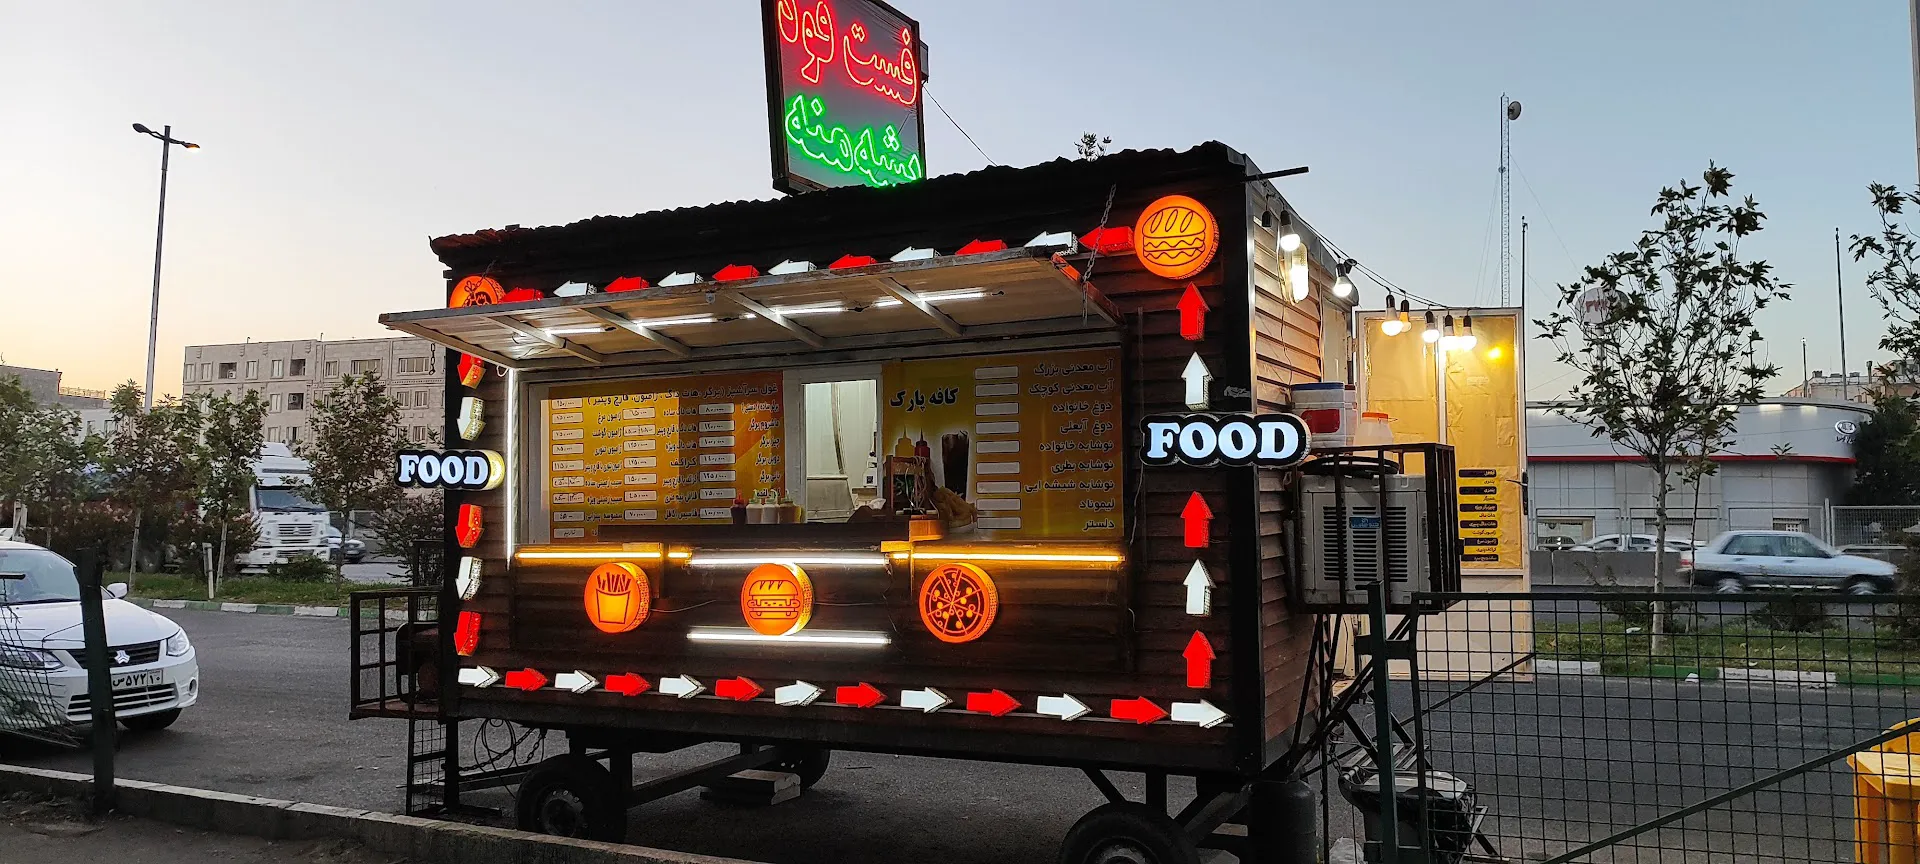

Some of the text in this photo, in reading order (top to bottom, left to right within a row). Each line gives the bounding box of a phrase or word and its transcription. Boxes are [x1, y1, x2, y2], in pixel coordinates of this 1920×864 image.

[843, 24, 917, 105] فست
[1034, 358, 1114, 377] آب معدنی بزرگ
[727, 383, 759, 398] سرآشپز
[760, 383, 778, 395] غول
[1029, 378, 1114, 398] آب معدنی کوچک
[890, 386, 960, 412] کافه پارک
[1052, 400, 1113, 416] دوغ خانواده
[1060, 418, 1114, 436] دوغ آبعلی
[1039, 440, 1114, 453] نوشابه خانواده
[1147, 422, 1299, 459] FOOD
[399, 454, 489, 484] FOOD
[670, 456, 697, 469] کراکف
[1051, 459, 1115, 474] نوشابه بطری
[1044, 479, 1077, 492] شیشه
[1079, 479, 1115, 492] نوشابه
[1079, 498, 1116, 511] لیموناد
[1082, 518, 1116, 532] دلستر
